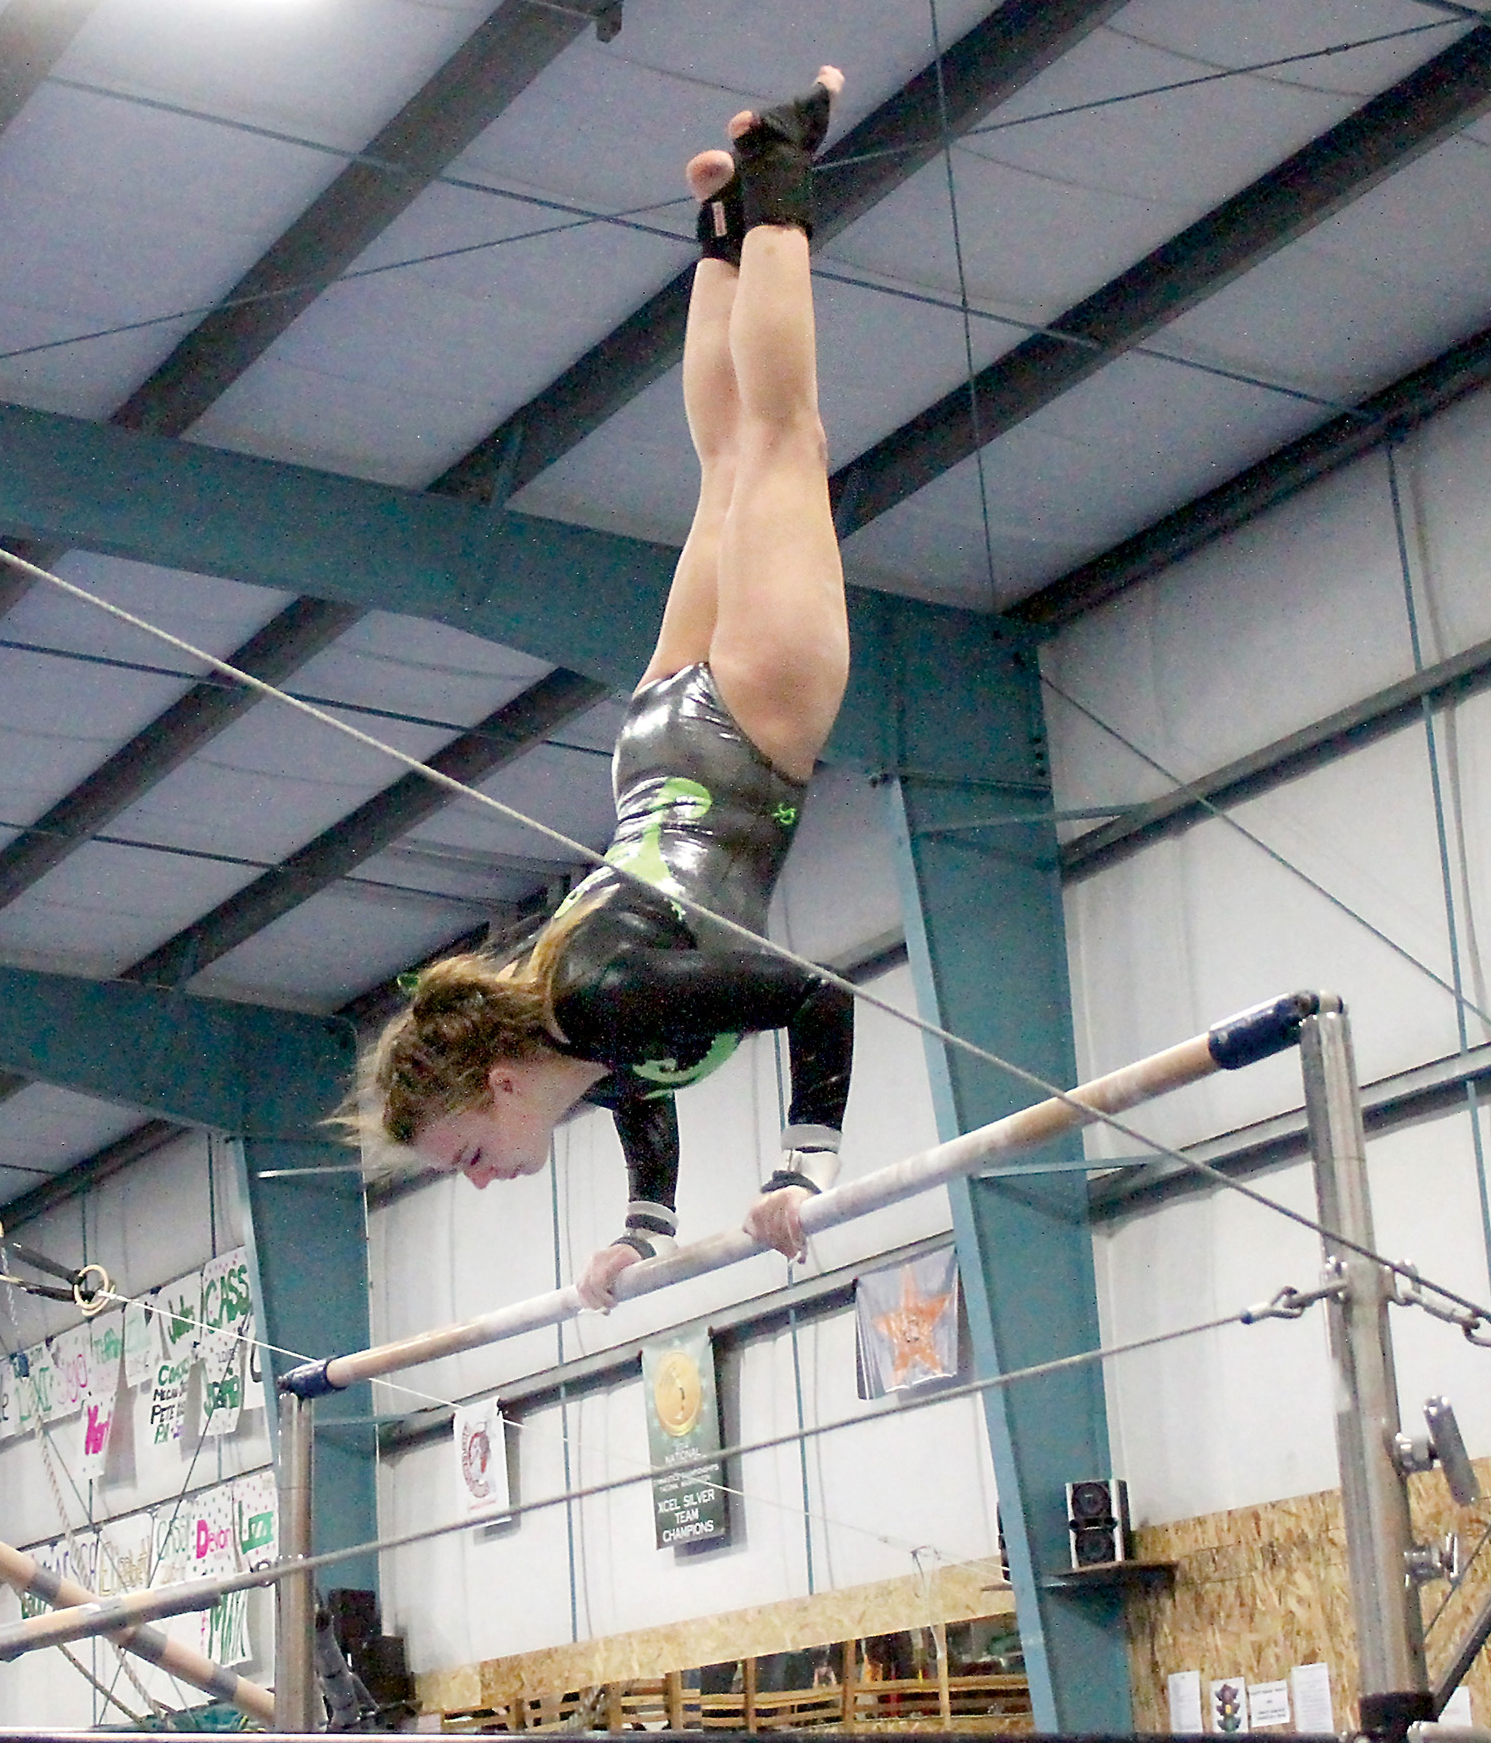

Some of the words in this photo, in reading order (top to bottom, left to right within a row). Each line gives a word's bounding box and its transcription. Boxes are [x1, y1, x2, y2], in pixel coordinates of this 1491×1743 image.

[205, 1264, 250, 1334] CASS
[657, 1498, 680, 1514] XCEL
[683, 1489, 715, 1508] SILVER
[674, 1507, 699, 1524] TEAM
[662, 1519, 714, 1543] CHAMPIONS
